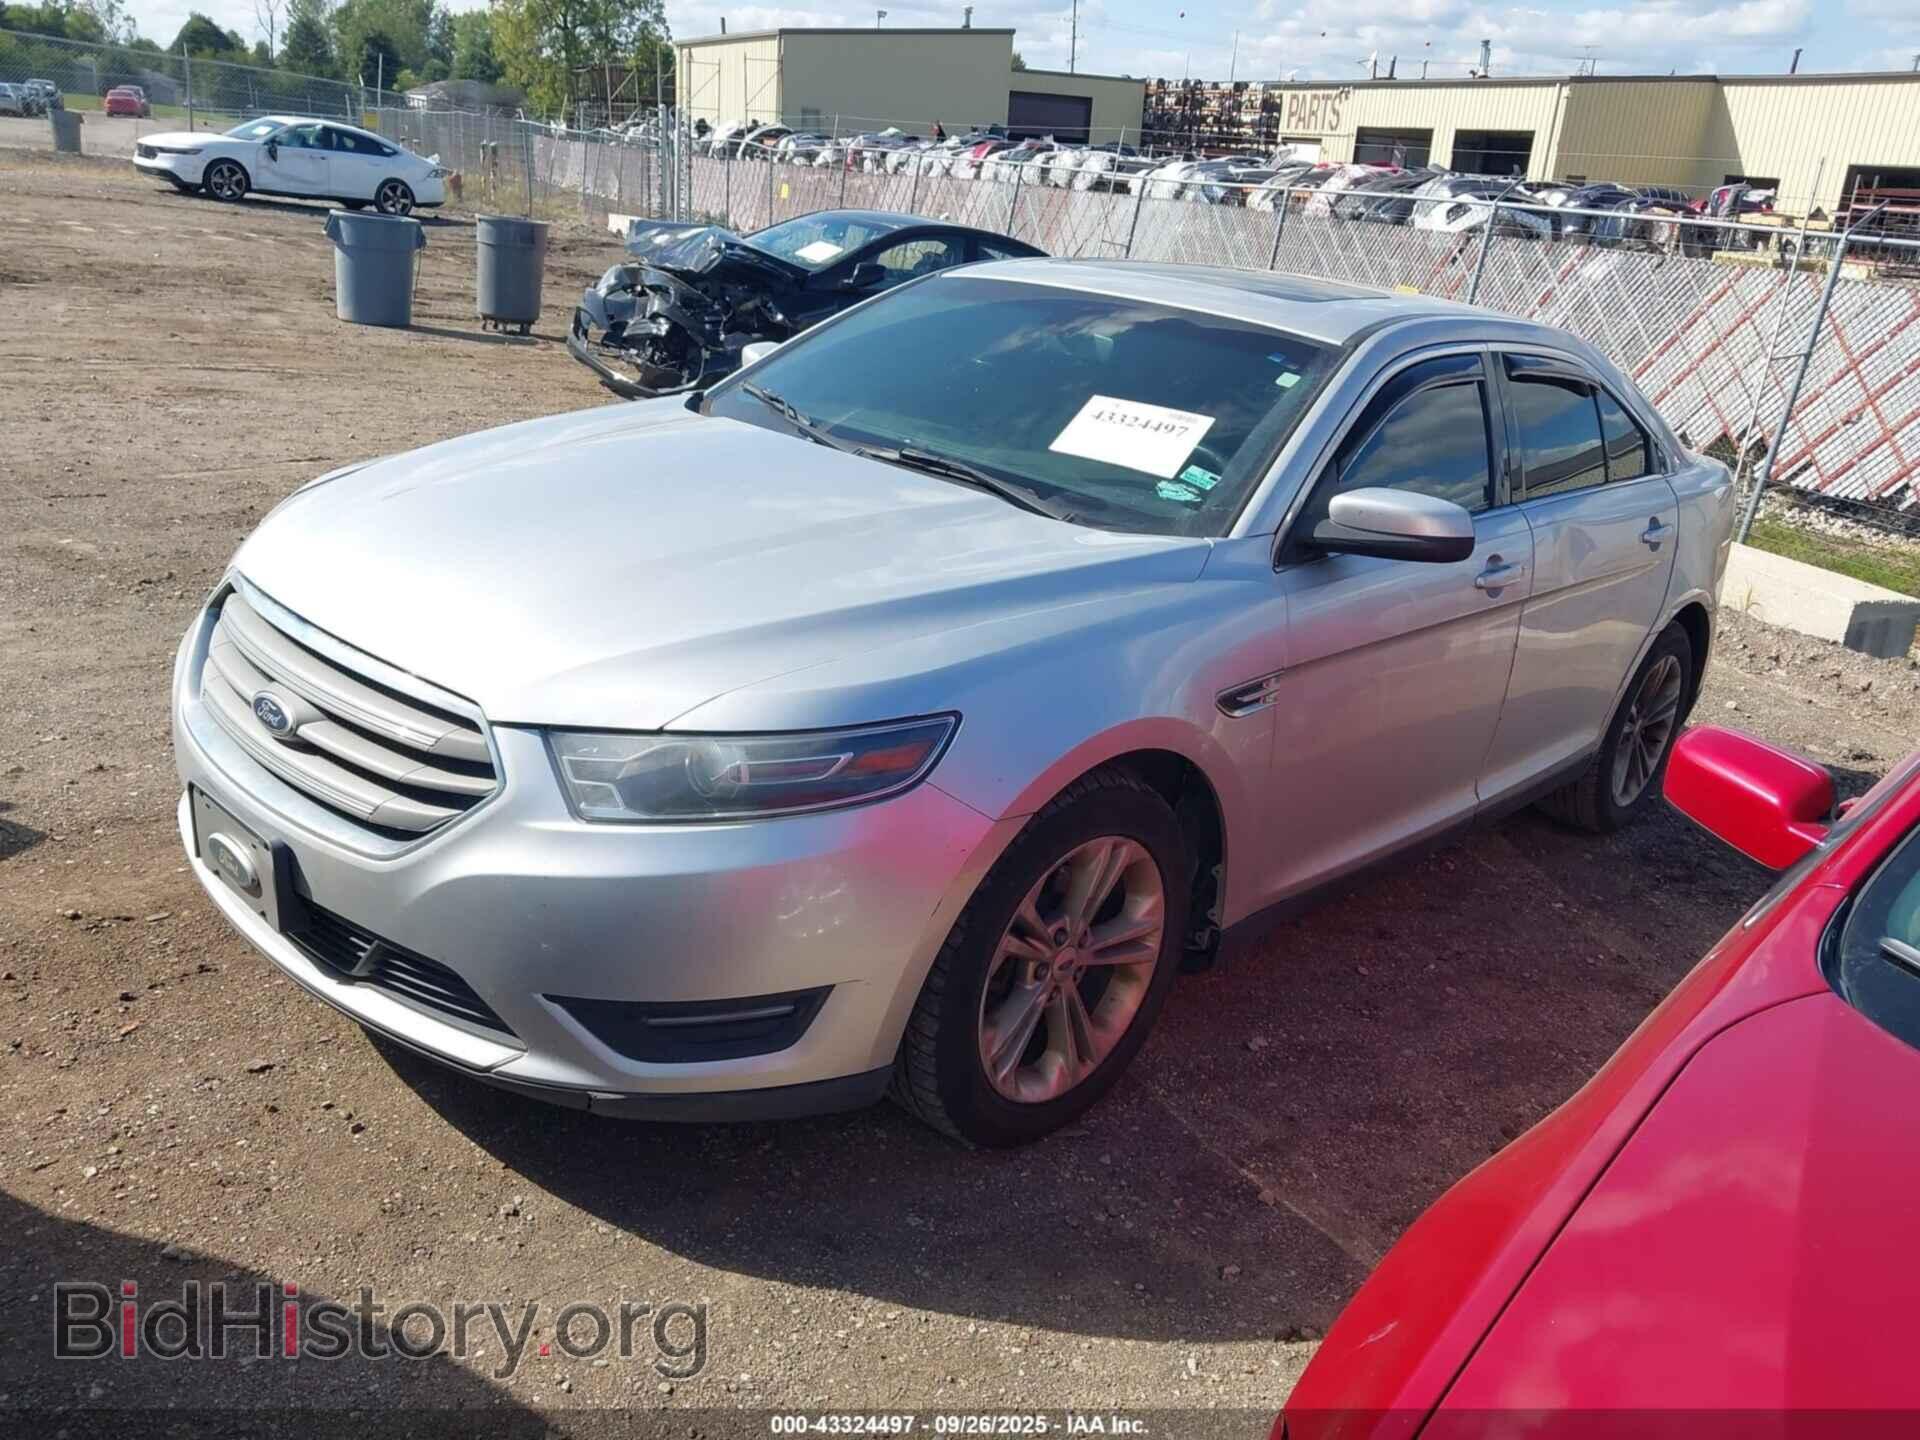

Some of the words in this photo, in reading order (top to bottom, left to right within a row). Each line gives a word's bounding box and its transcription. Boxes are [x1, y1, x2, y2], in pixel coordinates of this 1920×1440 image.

[1287, 92, 1343, 131] PARTS
[1090, 408, 1190, 439] 43324497
[256, 699, 282, 728] Ford
